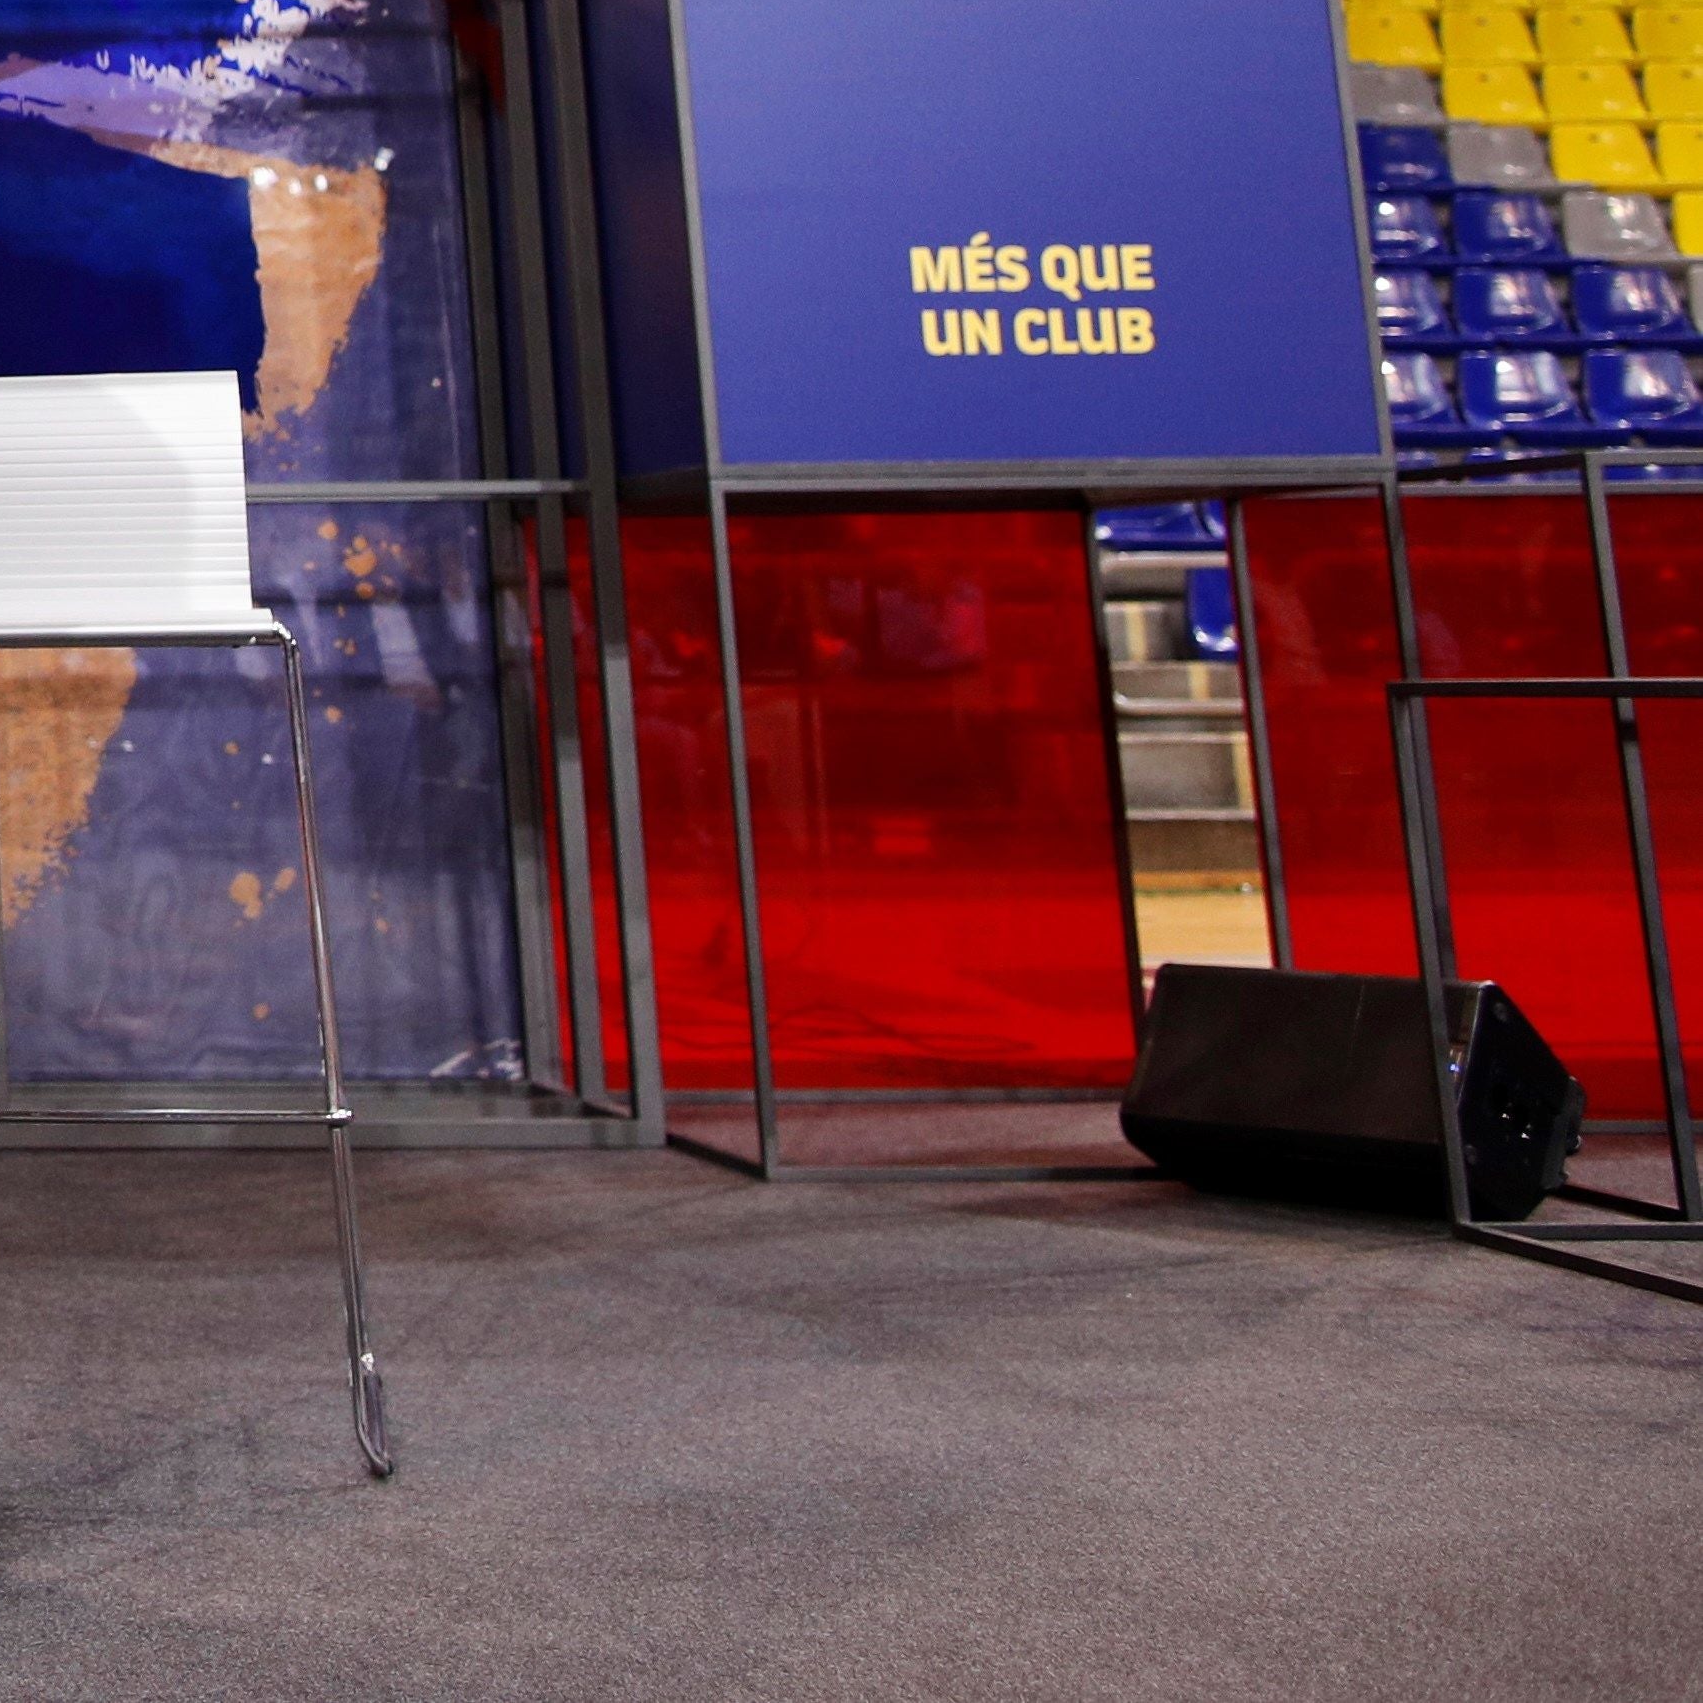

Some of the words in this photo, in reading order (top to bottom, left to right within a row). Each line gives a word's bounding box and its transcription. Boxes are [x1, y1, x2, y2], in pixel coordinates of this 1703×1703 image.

[909, 231, 1031, 293] MÉS
[1040, 243, 1156, 302] QUE
[921, 308, 1003, 357] UN
[1013, 306, 1156, 355] CLUB
